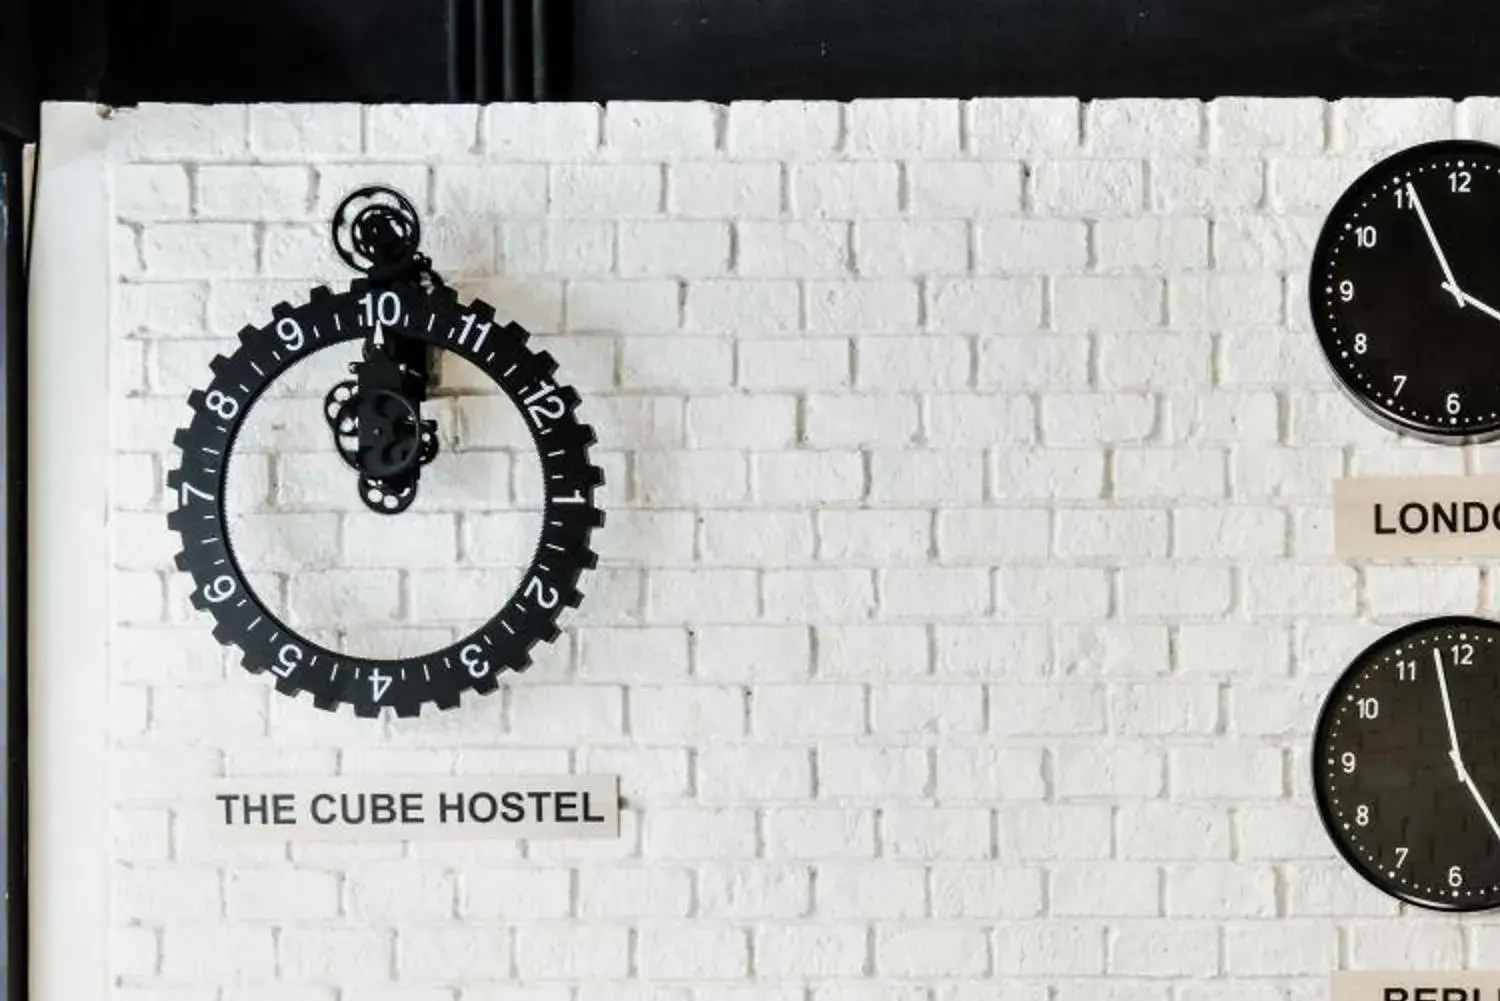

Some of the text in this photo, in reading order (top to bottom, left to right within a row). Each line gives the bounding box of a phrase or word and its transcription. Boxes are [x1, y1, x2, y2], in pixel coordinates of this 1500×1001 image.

[1448, 171, 1472, 193] 12
[1354, 225, 1377, 248] 10
[1339, 279, 1354, 302] 9
[358, 291, 401, 325] 10
[276, 317, 305, 351] 9
[458, 313, 490, 350] 11
[1353, 332, 1367, 355] 8
[1393, 375, 1407, 396] 7
[205, 389, 239, 420] 8
[522, 381, 565, 424] 12
[1446, 392, 1461, 415] 6
[181, 481, 215, 506] 7
[551, 489, 586, 504] 1
[203, 575, 237, 603] 6
[523, 575, 559, 609] 2
[271, 643, 303, 676] 5
[461, 643, 490, 678] 3
[1451, 643, 1474, 665] 12
[1396, 660, 1416, 681] 11
[368, 667, 393, 703] 4
[1356, 697, 1379, 720] 10
[1341, 751, 1356, 774] 9
[215, 791, 605, 825] THE CUBE HOSTEL
[1355, 804, 1369, 827] 8
[1395, 847, 1409, 869] 7
[1447, 865, 1463, 888] 6
